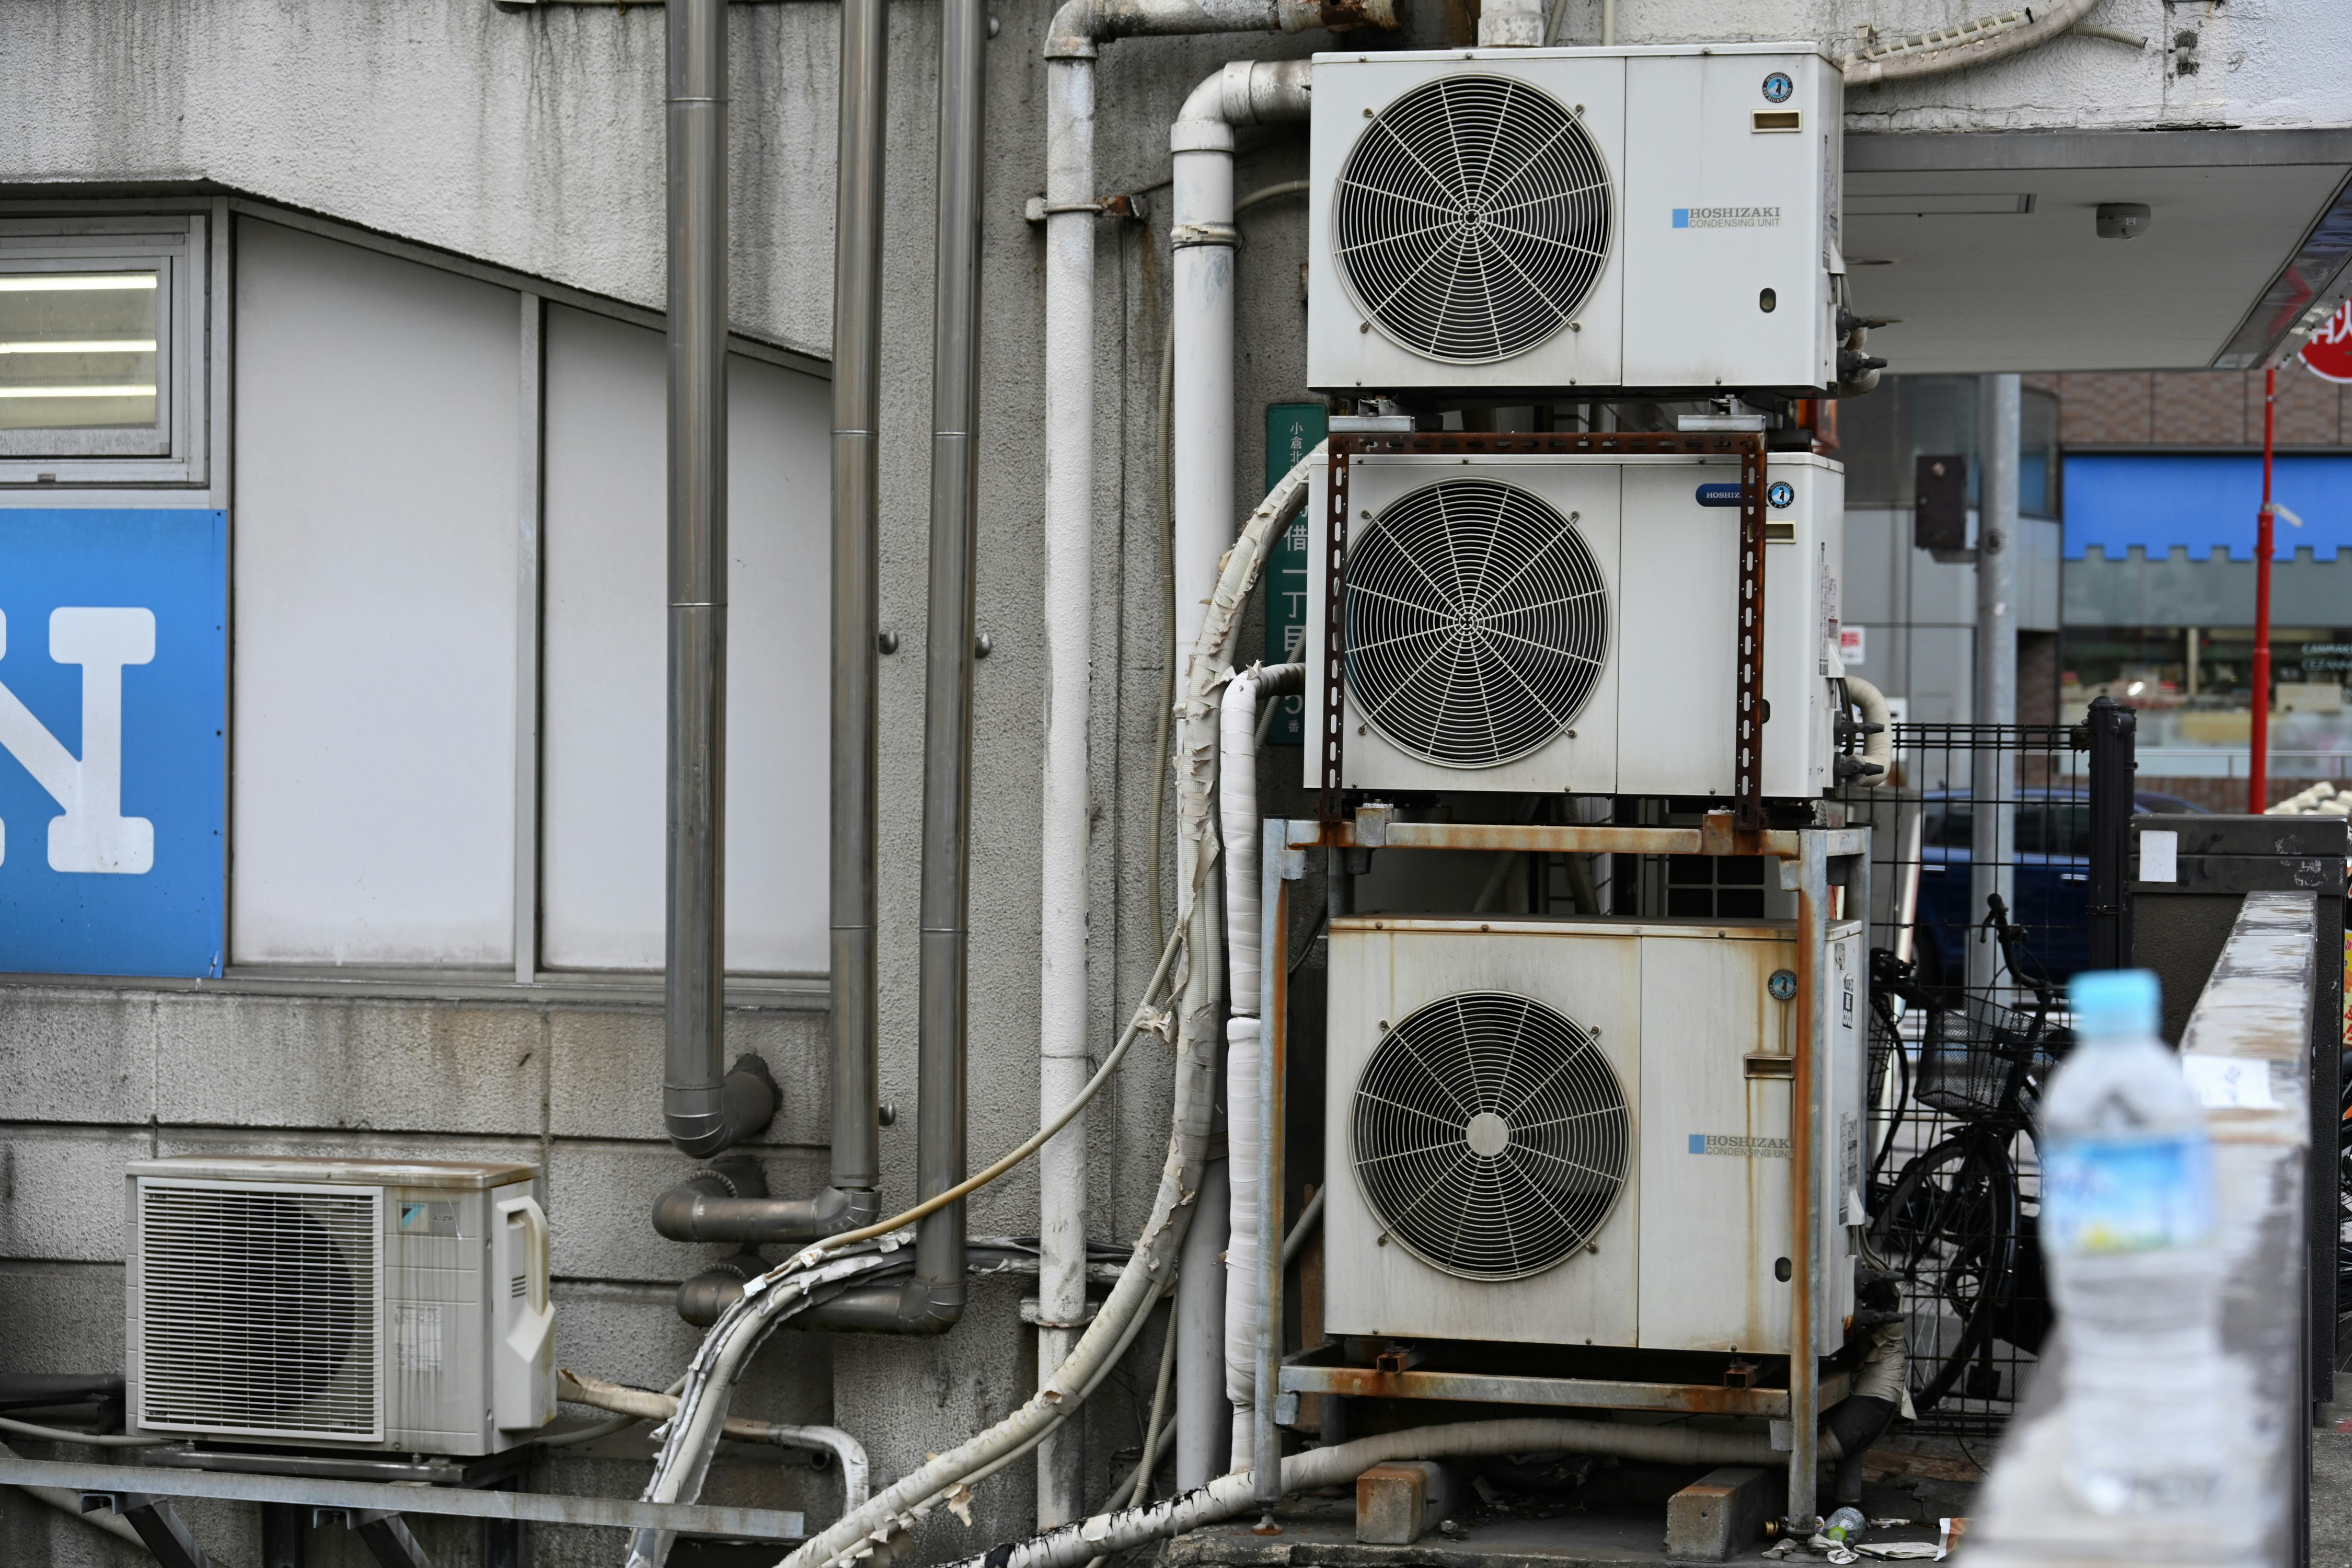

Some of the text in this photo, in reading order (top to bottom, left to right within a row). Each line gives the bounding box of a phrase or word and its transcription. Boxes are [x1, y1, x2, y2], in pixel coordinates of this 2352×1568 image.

[1762, 87, 1792, 102] REFRIGERATOR
[1689, 207, 1781, 218] HOSHIZAKI
[1689, 218, 1781, 228] CONDENSING UNIT
[1289, 421, 1304, 470] 小倉北
[1282, 505, 1308, 652] 借一丁目
[1705, 1146, 1771, 1157] CONDENSING
